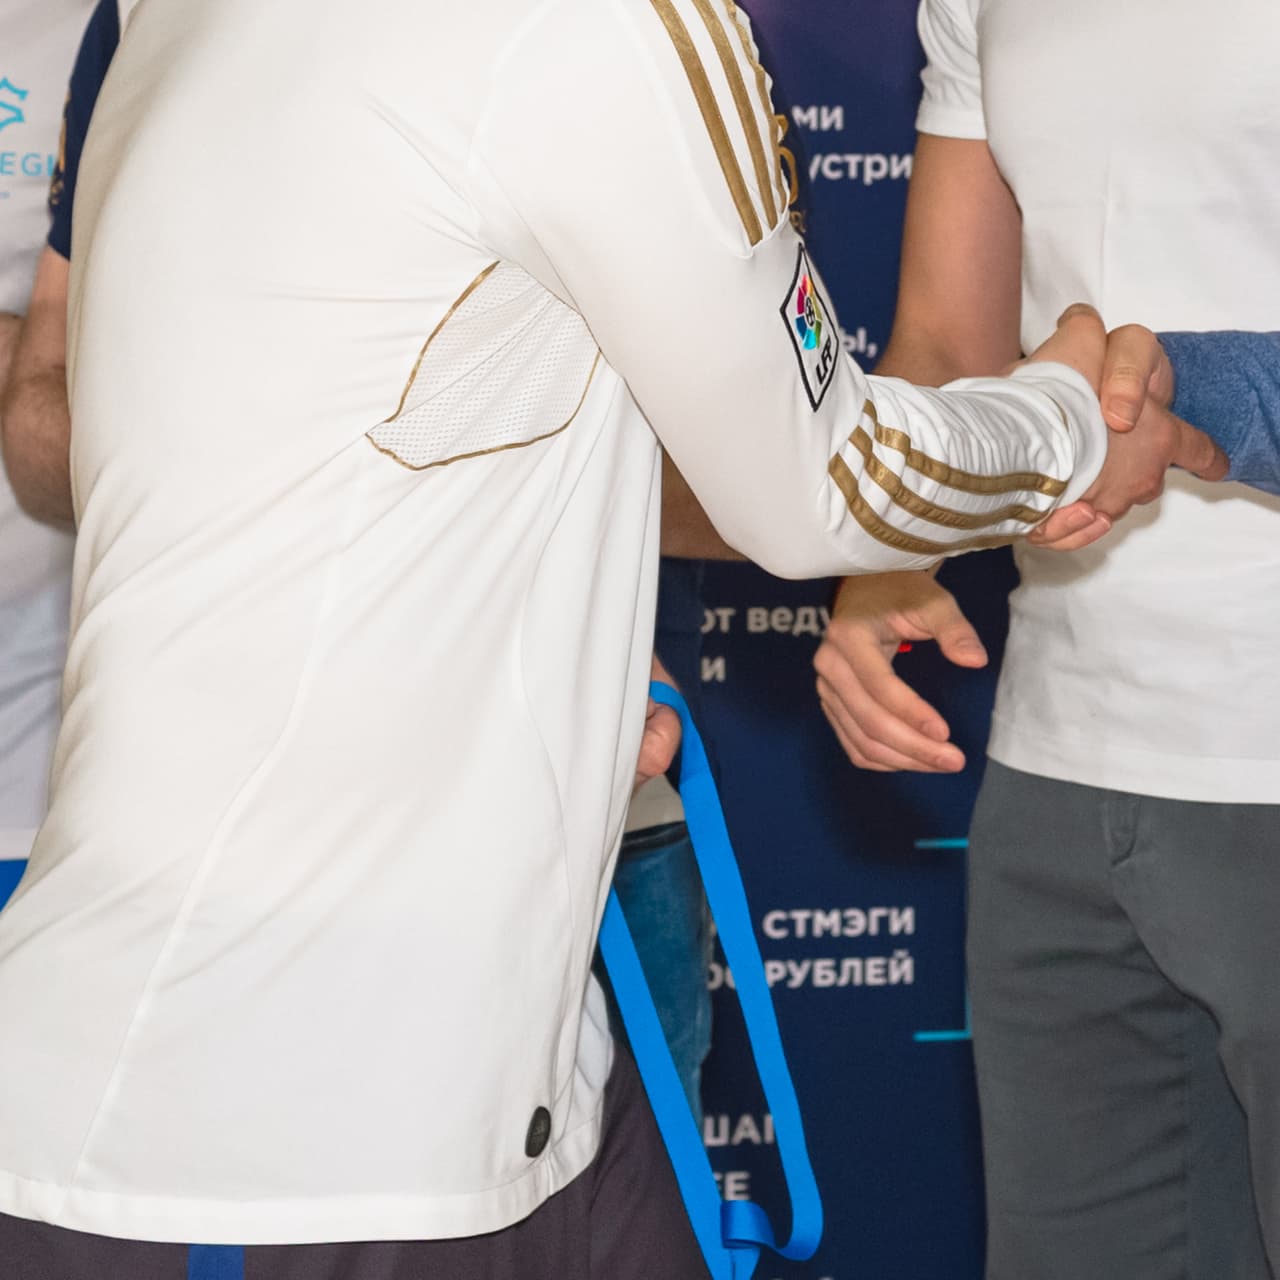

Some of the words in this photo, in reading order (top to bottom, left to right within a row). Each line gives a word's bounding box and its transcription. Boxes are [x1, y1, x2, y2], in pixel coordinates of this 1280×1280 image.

[746, 605, 831, 638] вед
[762, 906, 916, 940] СТМЭГИ
[764, 948, 915, 990] РУБЛЕЙ
